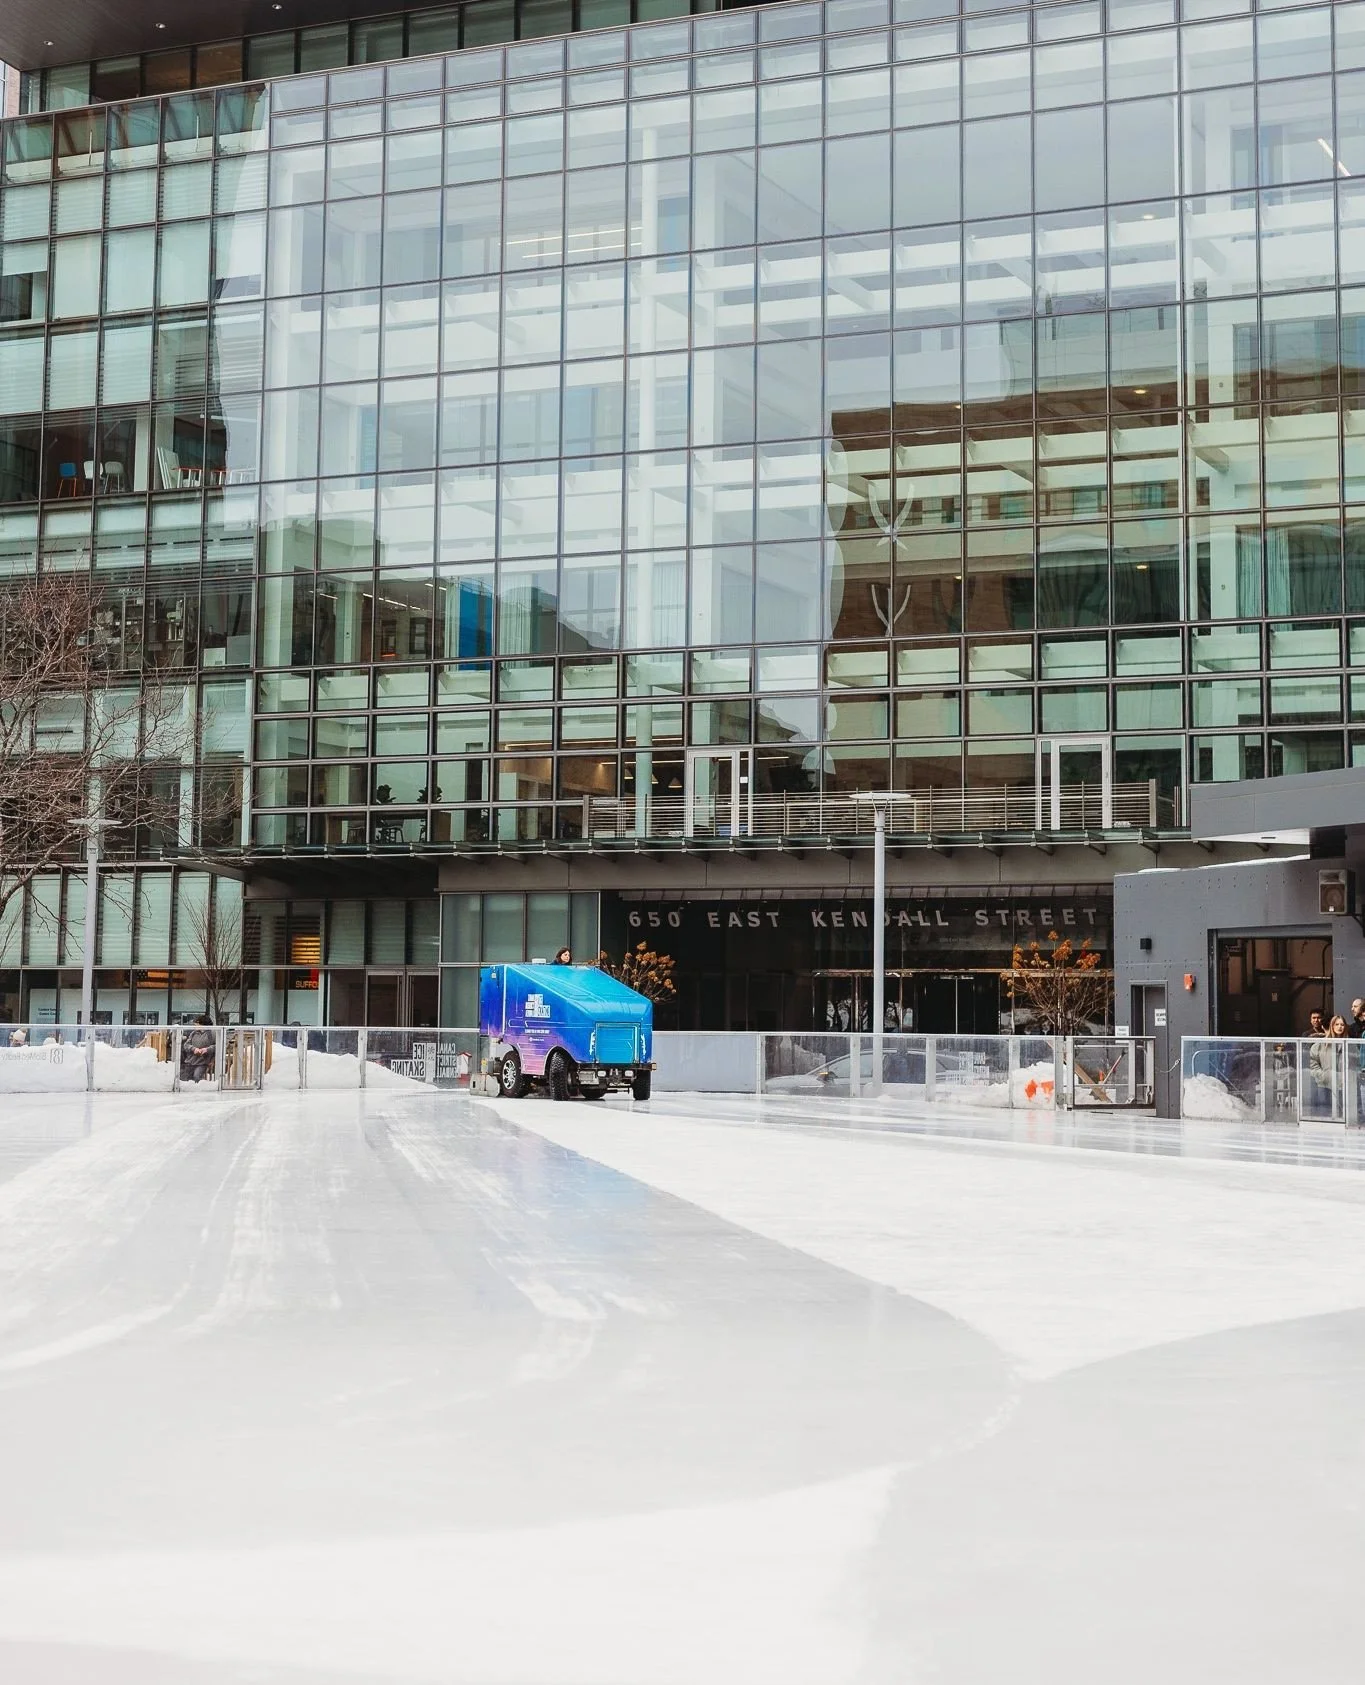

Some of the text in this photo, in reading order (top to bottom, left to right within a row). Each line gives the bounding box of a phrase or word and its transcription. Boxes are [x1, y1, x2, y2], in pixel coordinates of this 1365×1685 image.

[628, 911, 681, 928] 650
[707, 911, 779, 928] EAST
[974, 908, 1097, 926] STREET
